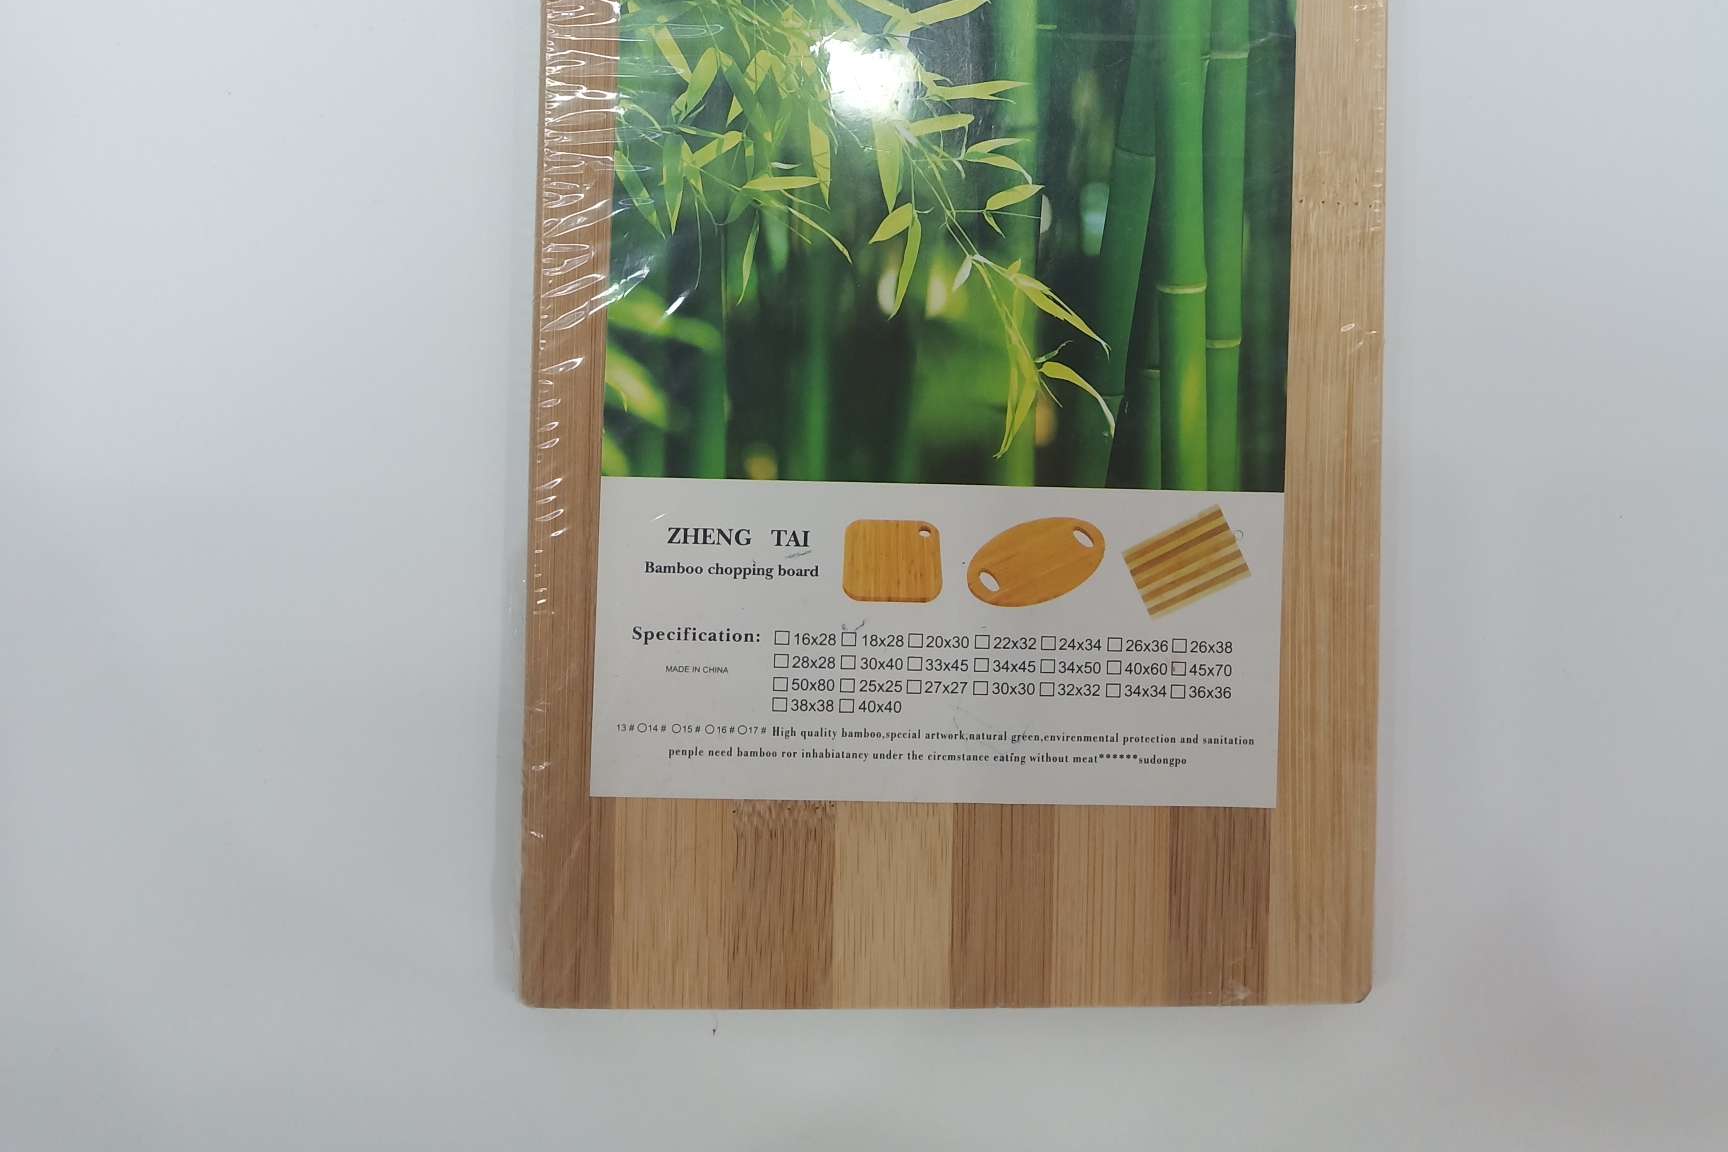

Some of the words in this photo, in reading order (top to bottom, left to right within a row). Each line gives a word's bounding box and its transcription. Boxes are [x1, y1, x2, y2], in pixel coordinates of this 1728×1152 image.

[667, 527, 752, 546] ZHENG
[770, 529, 810, 548] TAI
[645, 560, 704, 575] Bamboo
[707, 560, 775, 580] chopping
[778, 564, 819, 578] board
[632, 626, 760, 646] Specification:
[794, 632, 837, 647] 16x28
[862, 634, 905, 648] 18x28
[925, 635, 970, 649] 20x30
[992, 636, 1037, 650] 22x32
[1058, 637, 1102, 652] 24x34
[1125, 639, 1169, 653] 26x36
[1189, 640, 1233, 654] 26x38
[665, 665, 690, 673] MADE
[691, 665, 701, 673] IN
[702, 665, 729, 674] CHINA
[791, 655, 836, 670] 28x28
[860, 656, 904, 671] 30x40
[925, 658, 969, 672] 33x45
[992, 659, 1036, 674] 34x45
[1058, 660, 1102, 675] 34x50
[1124, 662, 1168, 676] 40x60
[1188, 663, 1233, 677] 45x70
[791, 678, 835, 692] 50x80
[859, 679, 903, 693] 25x25
[923, 678, 969, 696] 27x27
[991, 681, 1036, 696] 30x30
[1057, 683, 1101, 697] 32x32
[1124, 684, 1167, 698] 34x34
[1188, 685, 1232, 700] 36x36
[790, 698, 834, 713] 38x38
[858, 700, 902, 714] 40x40
[772, 725, 797, 740] High
[800, 727, 837, 741] quality
[1180, 733, 1199, 744] and
[708, 746, 733, 757] need
[736, 746, 778, 758] bamboo
[872, 748, 904, 760] under
[907, 749, 924, 761] the
[1029, 752, 1069, 763] without
